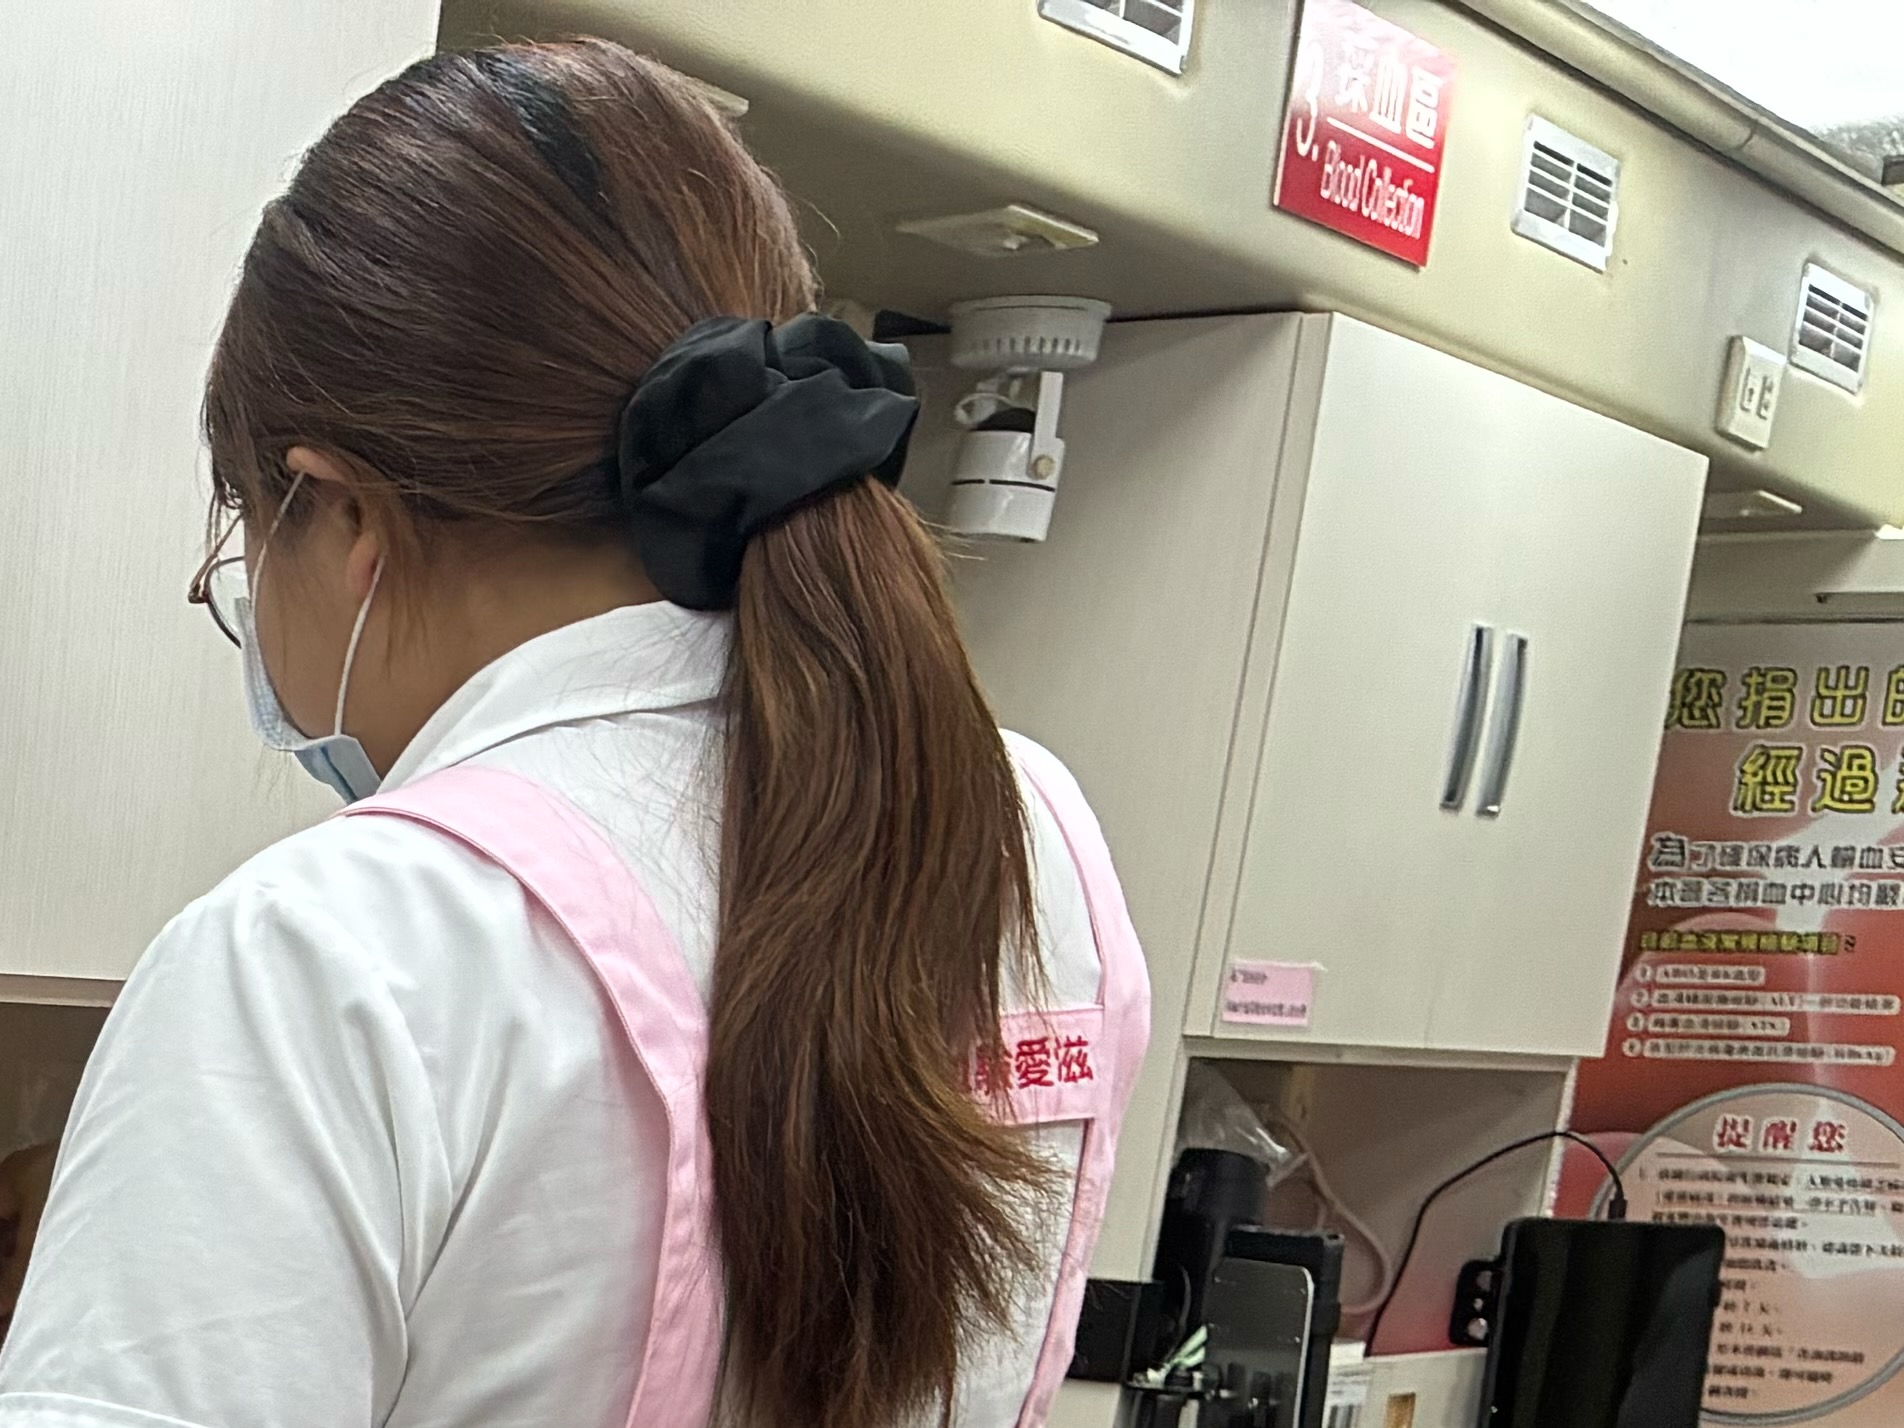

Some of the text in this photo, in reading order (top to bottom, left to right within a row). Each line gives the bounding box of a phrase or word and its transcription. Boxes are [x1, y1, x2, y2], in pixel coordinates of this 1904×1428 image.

[1334, 50, 1444, 150] 採血區
[1320, 140, 1425, 240] Blood Collection
[1733, 744, 1904, 813] 經過
[1717, 1115, 1846, 1153] 提醒您
